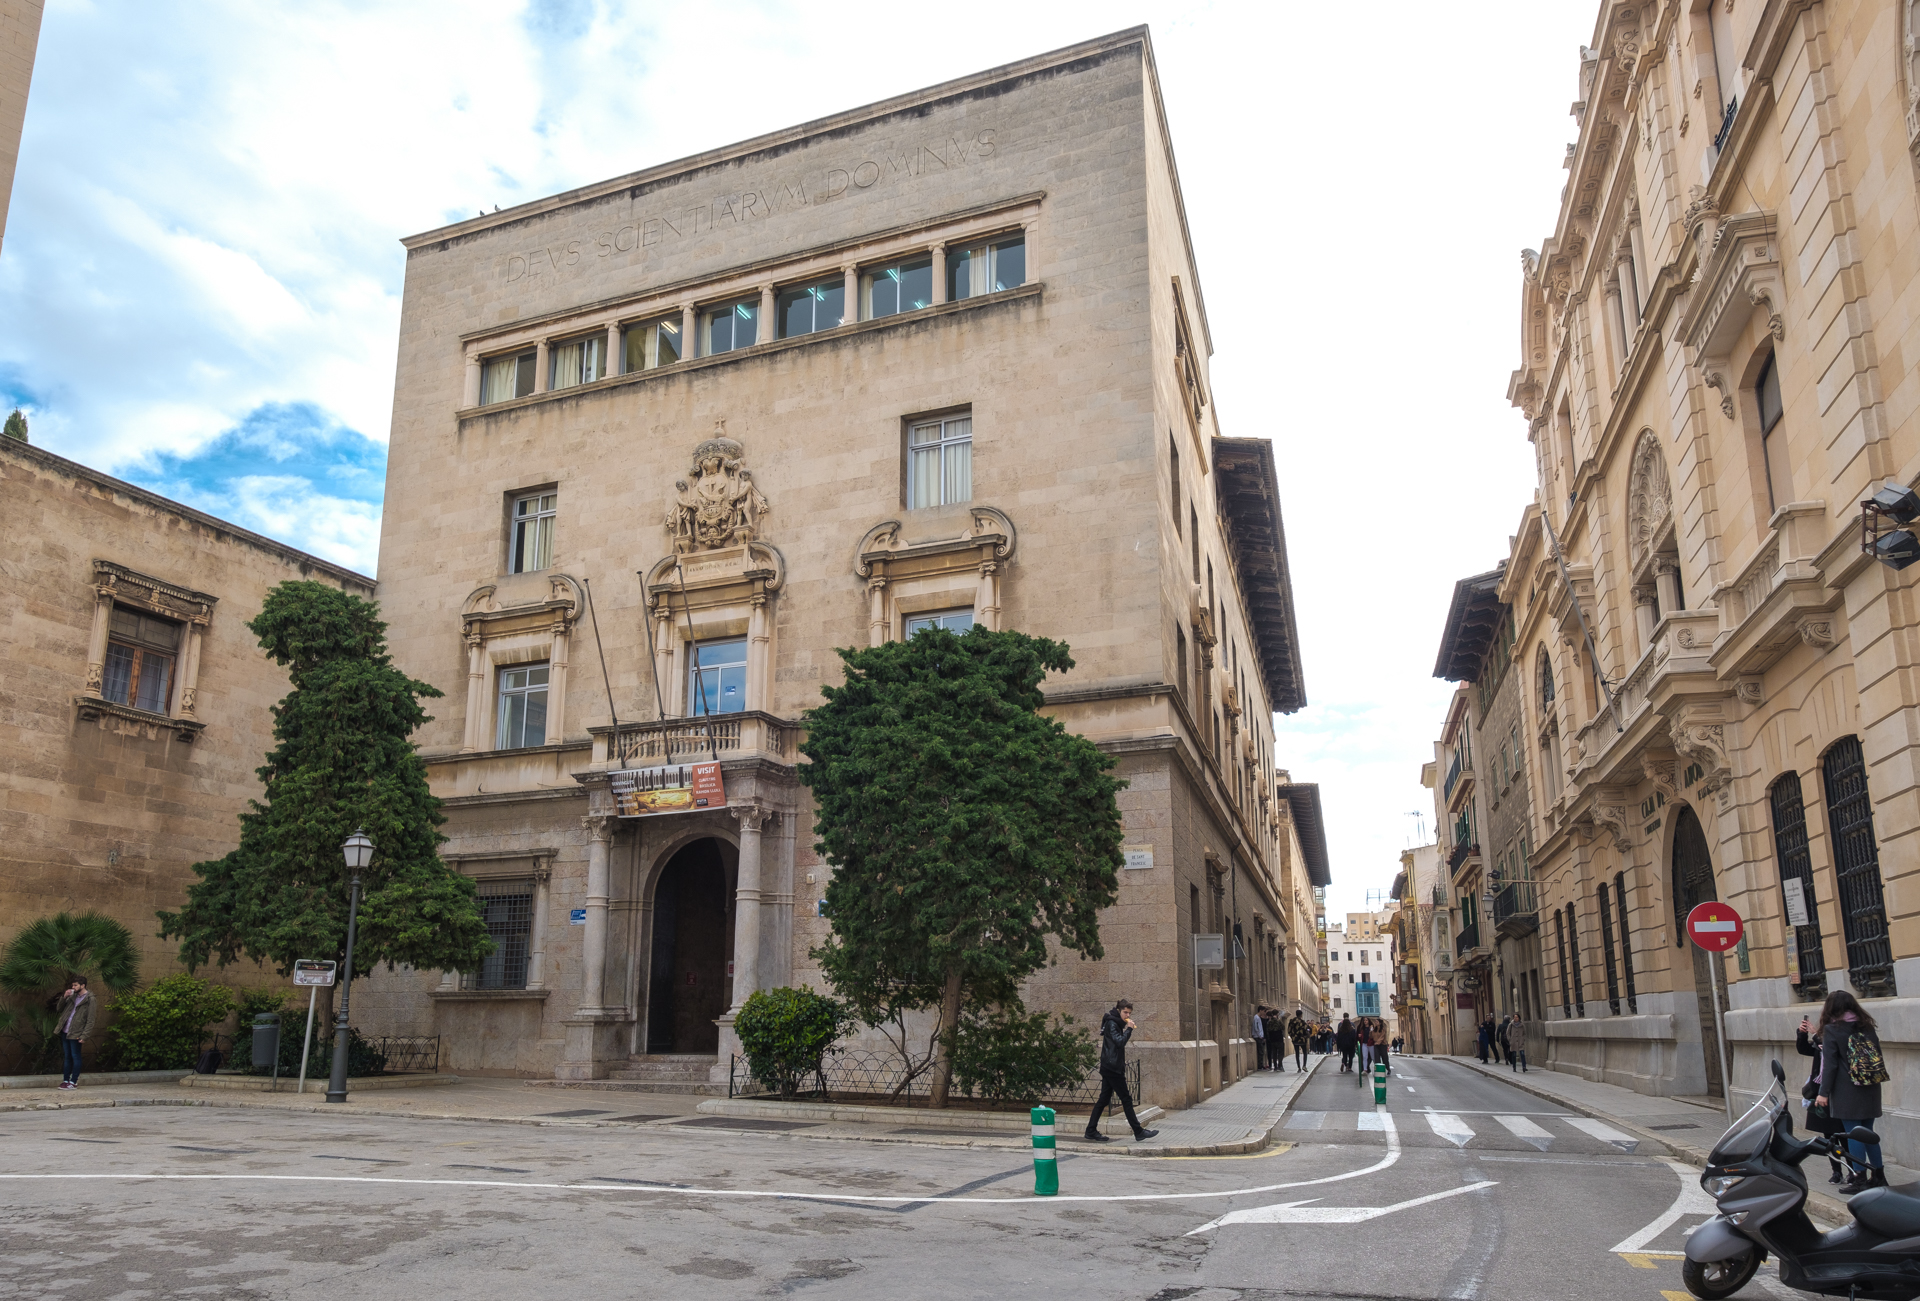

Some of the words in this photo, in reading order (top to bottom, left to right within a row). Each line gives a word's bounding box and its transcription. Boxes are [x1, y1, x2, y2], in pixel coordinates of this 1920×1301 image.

[507, 240, 581, 283] DEVS
[597, 179, 808, 257] SCIENTIARVM
[825, 128, 995, 201] DOMINVS
[697, 766, 715, 775] VISIT
